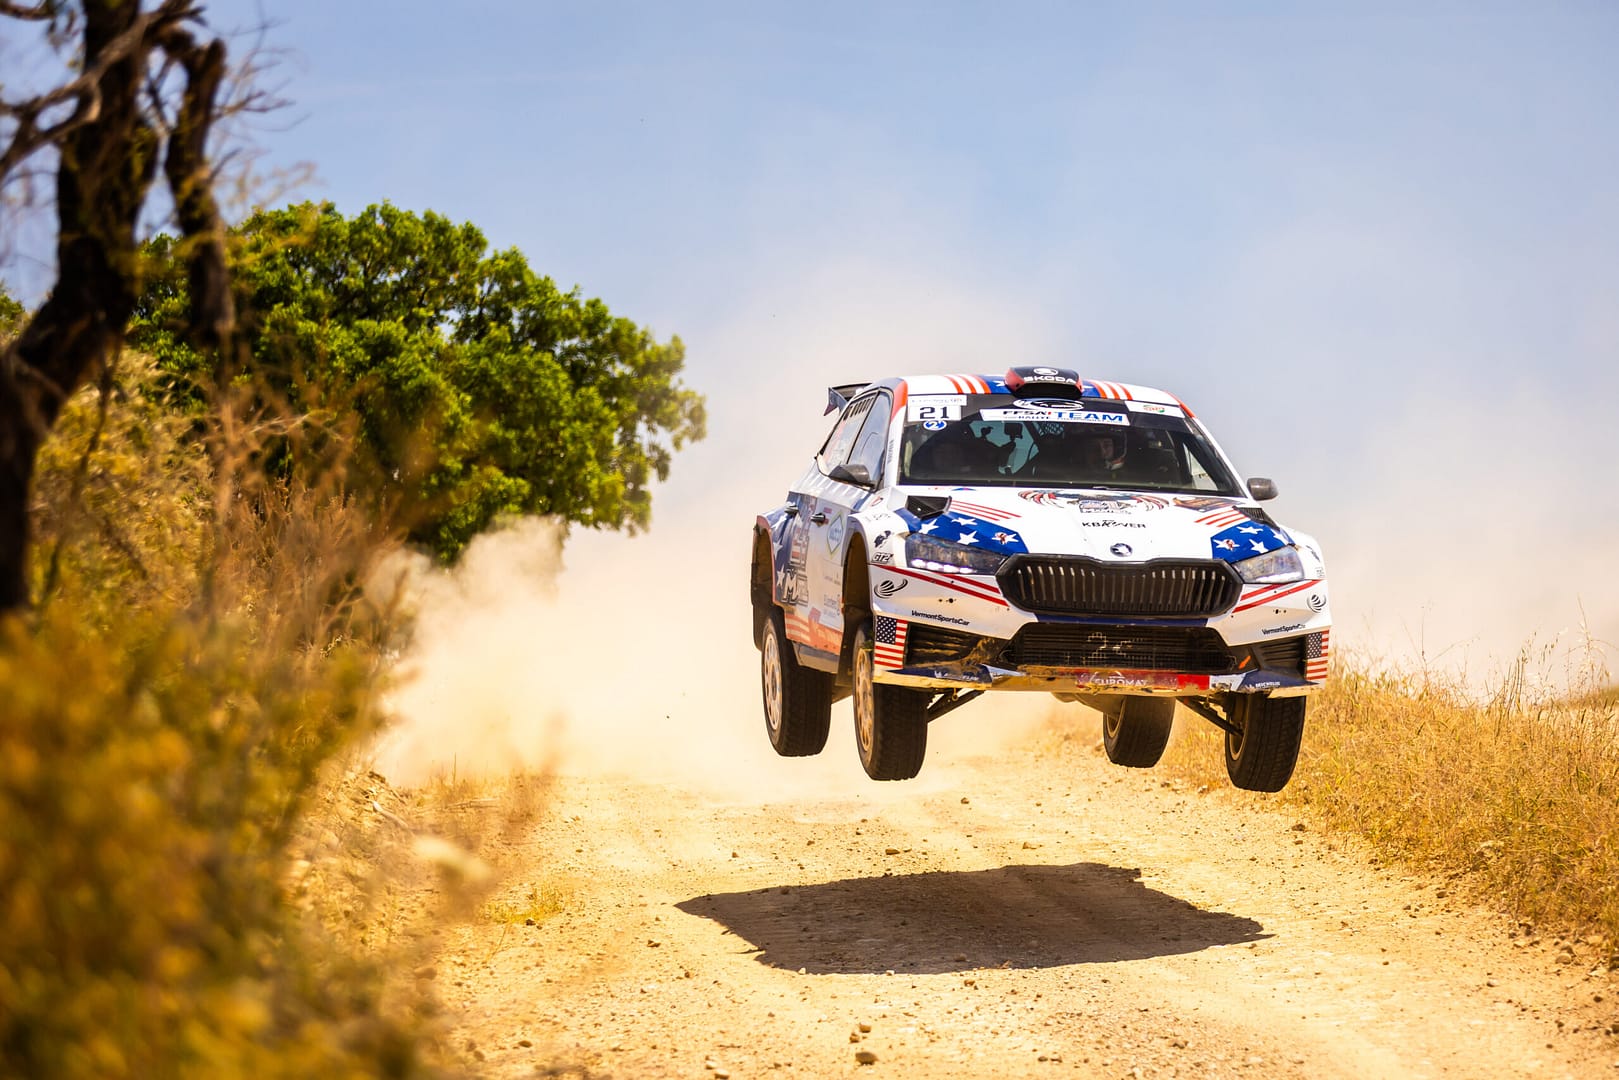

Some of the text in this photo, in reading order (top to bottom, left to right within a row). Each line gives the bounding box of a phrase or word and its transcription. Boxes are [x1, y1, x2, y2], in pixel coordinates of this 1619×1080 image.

[919, 406, 949, 420] 21
[1054, 411, 1123, 422] TEAM
[911, 610, 970, 626] VermontSportsCar
